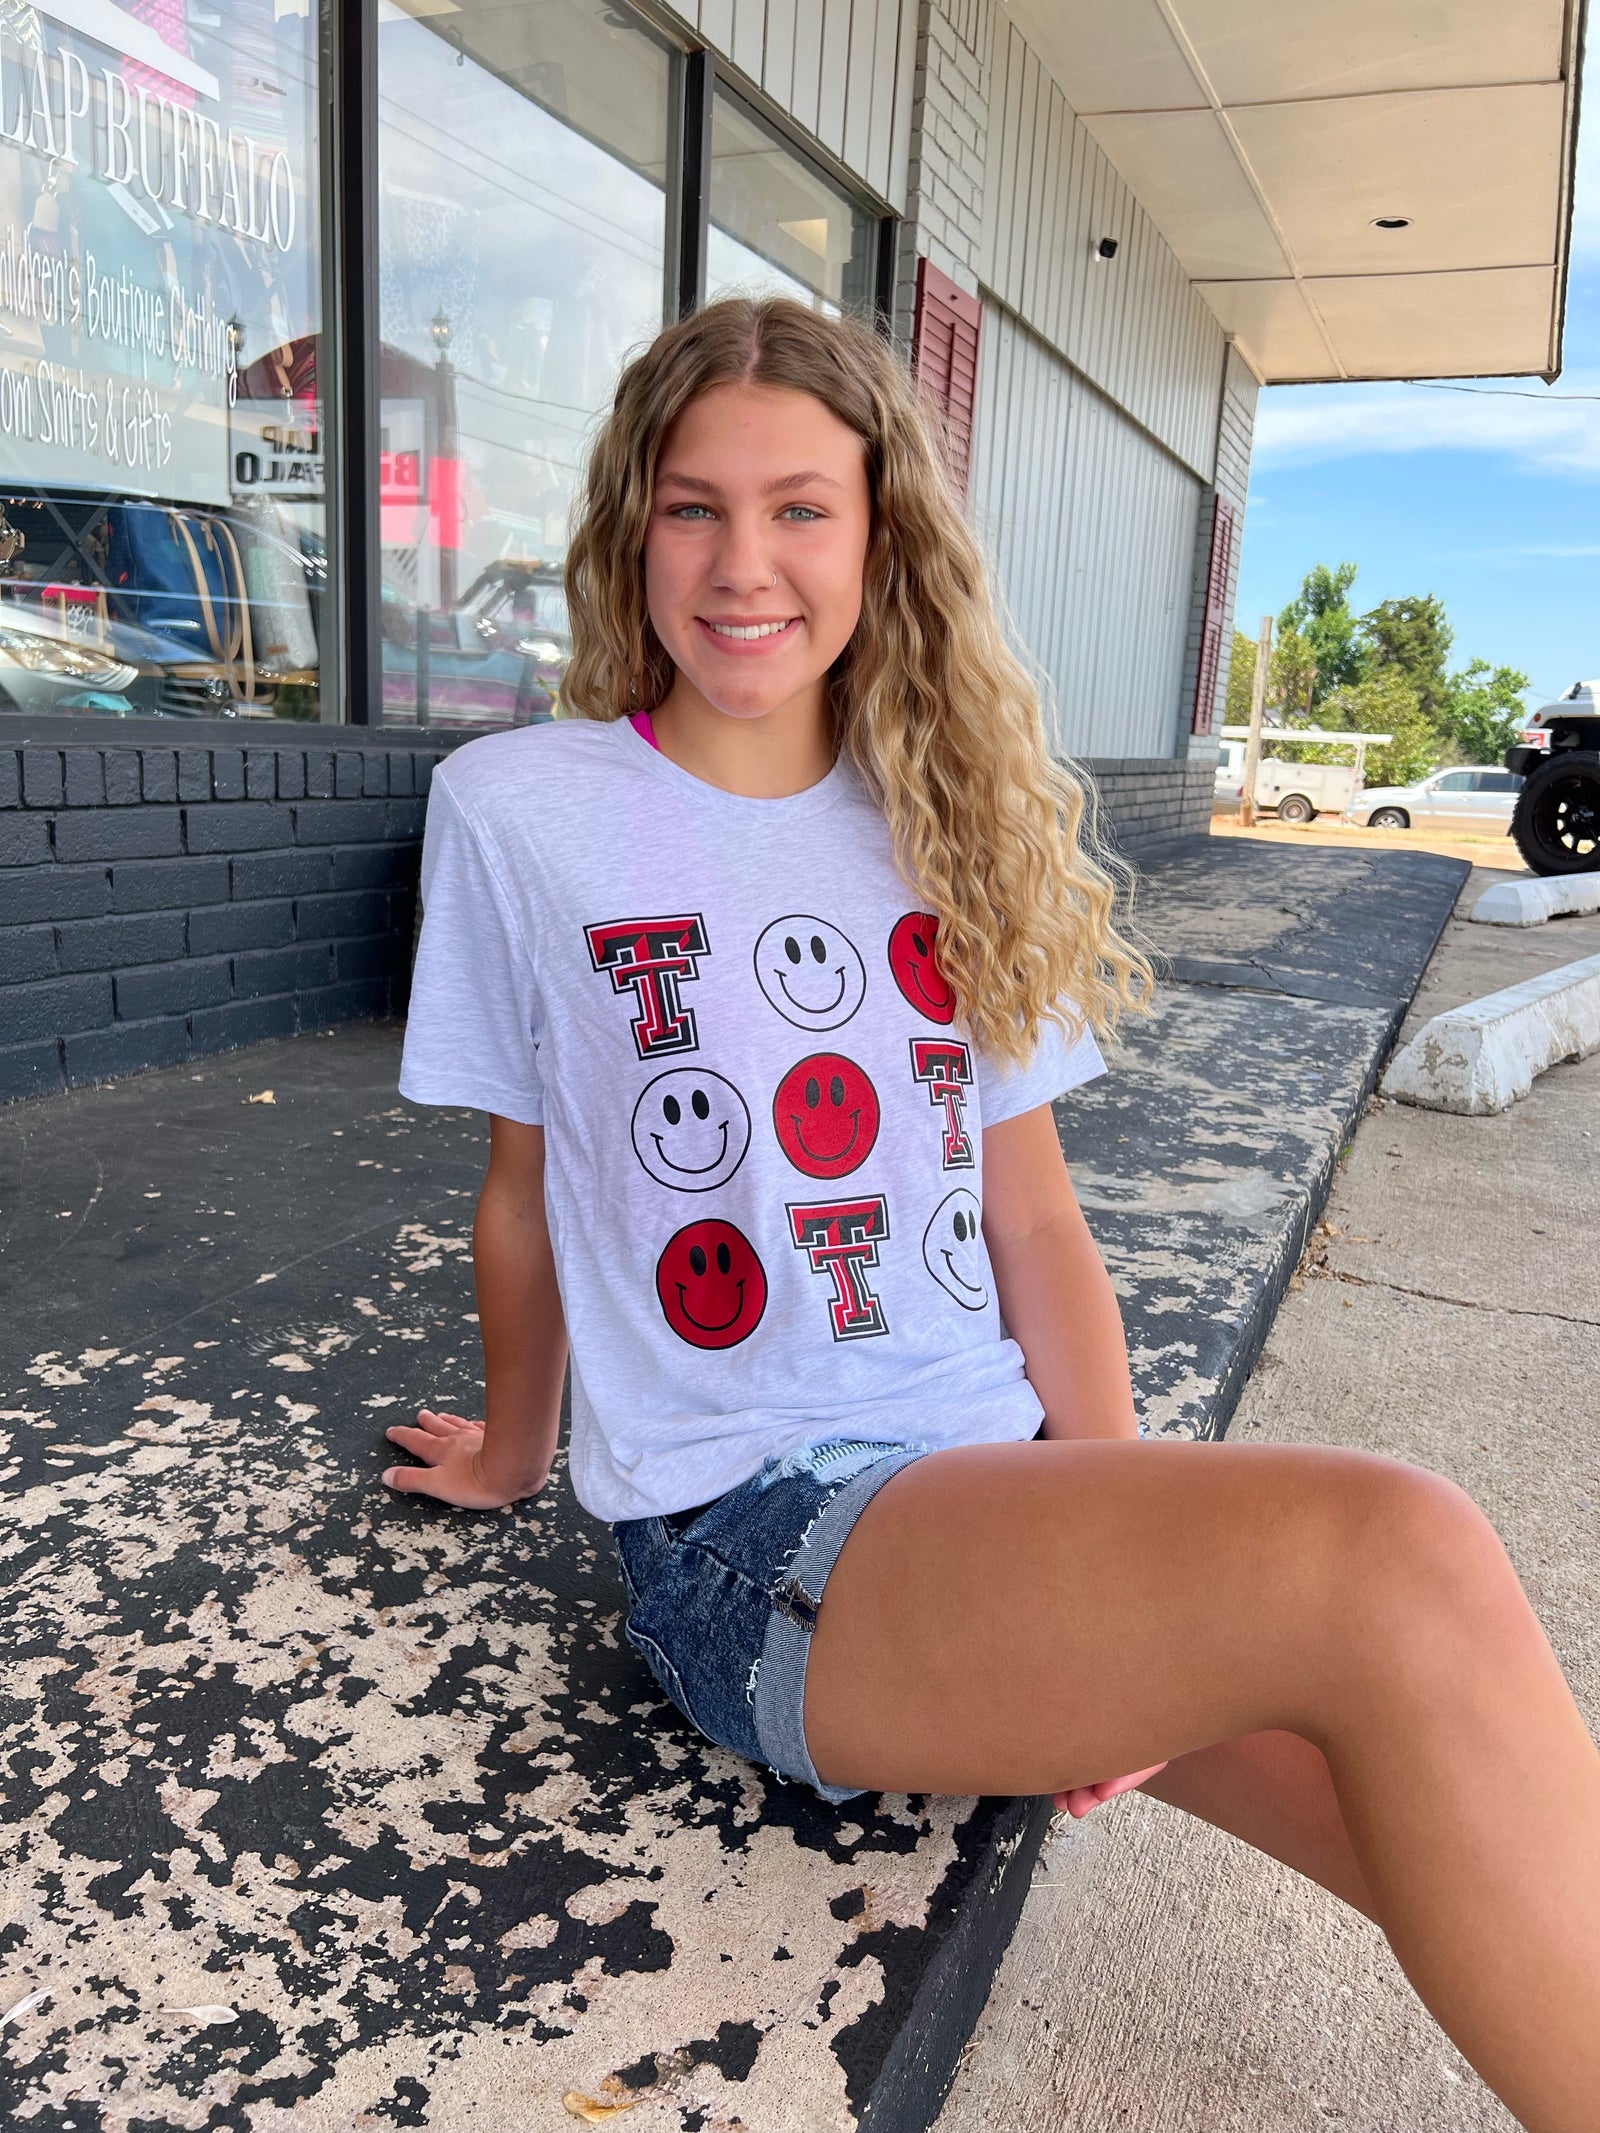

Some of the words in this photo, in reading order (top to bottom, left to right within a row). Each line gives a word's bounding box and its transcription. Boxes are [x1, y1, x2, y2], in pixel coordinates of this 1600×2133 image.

[101, 67, 295, 251] BUFFALO
[87, 249, 165, 381] Boutique
[170, 285, 238, 408] Clothing
[37, 359, 98, 451] Shirts
[105, 377, 119, 460] &
[123, 386, 172, 471] Gifts
